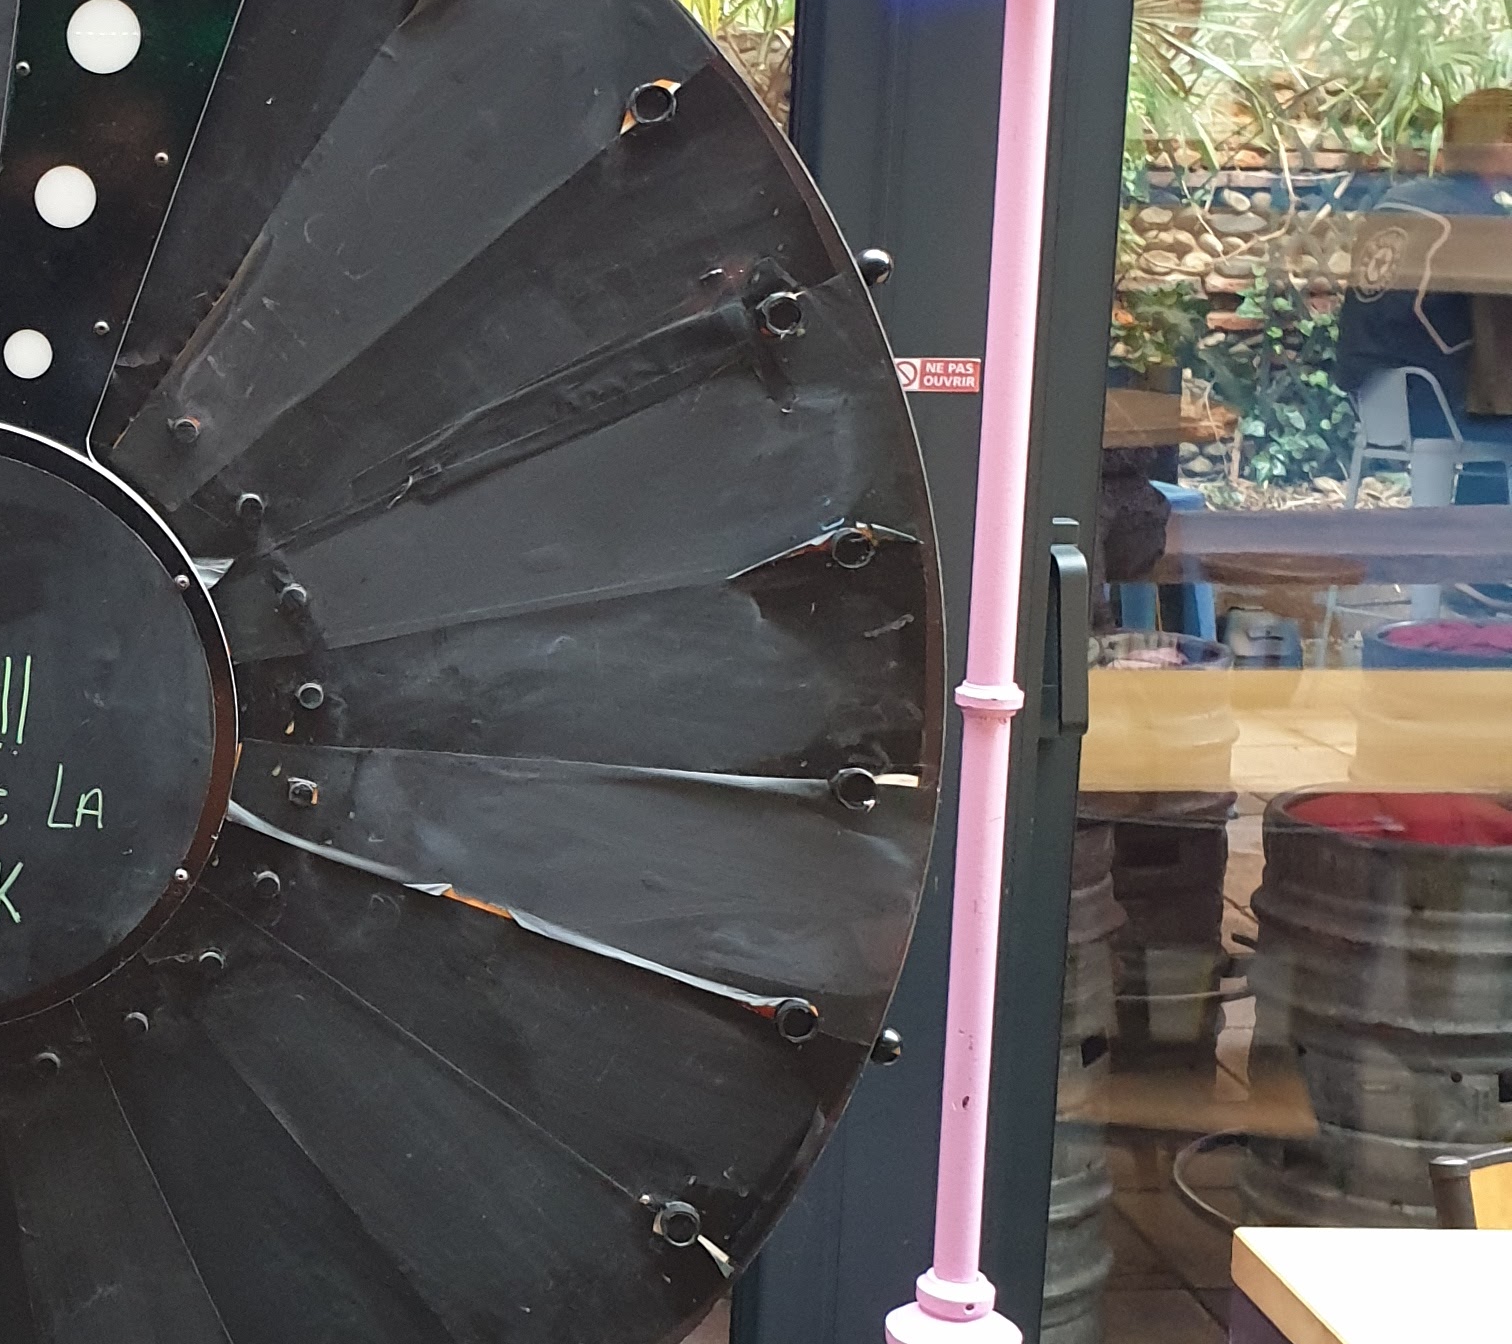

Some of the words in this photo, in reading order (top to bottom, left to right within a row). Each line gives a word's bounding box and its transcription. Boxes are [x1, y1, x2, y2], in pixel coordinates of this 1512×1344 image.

[926, 362, 945, 374] NE
[948, 363, 975, 375] PAS
[923, 375, 976, 388] OUVRIR
